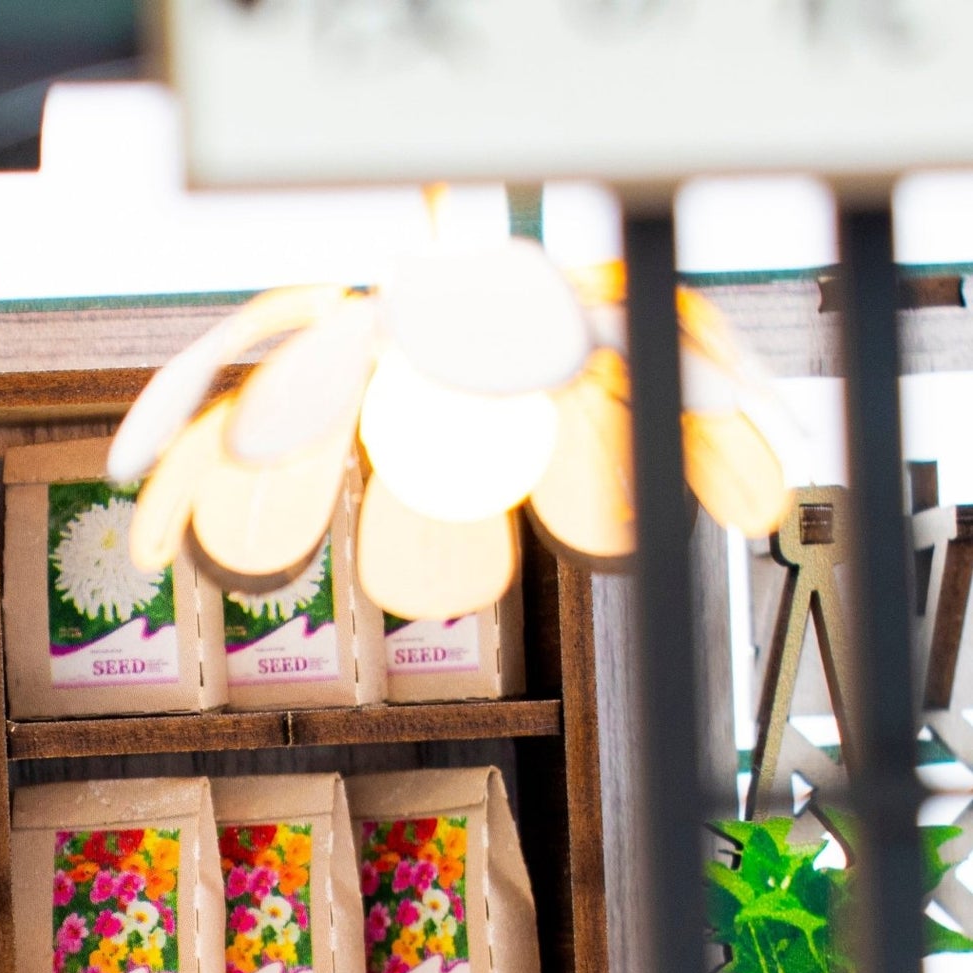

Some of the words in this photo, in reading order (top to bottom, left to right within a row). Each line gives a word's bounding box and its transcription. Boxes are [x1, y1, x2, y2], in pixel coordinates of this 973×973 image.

[394, 646, 448, 664] SEED
[92, 658, 146, 676] SEED
[257, 656, 308, 675] SEED
